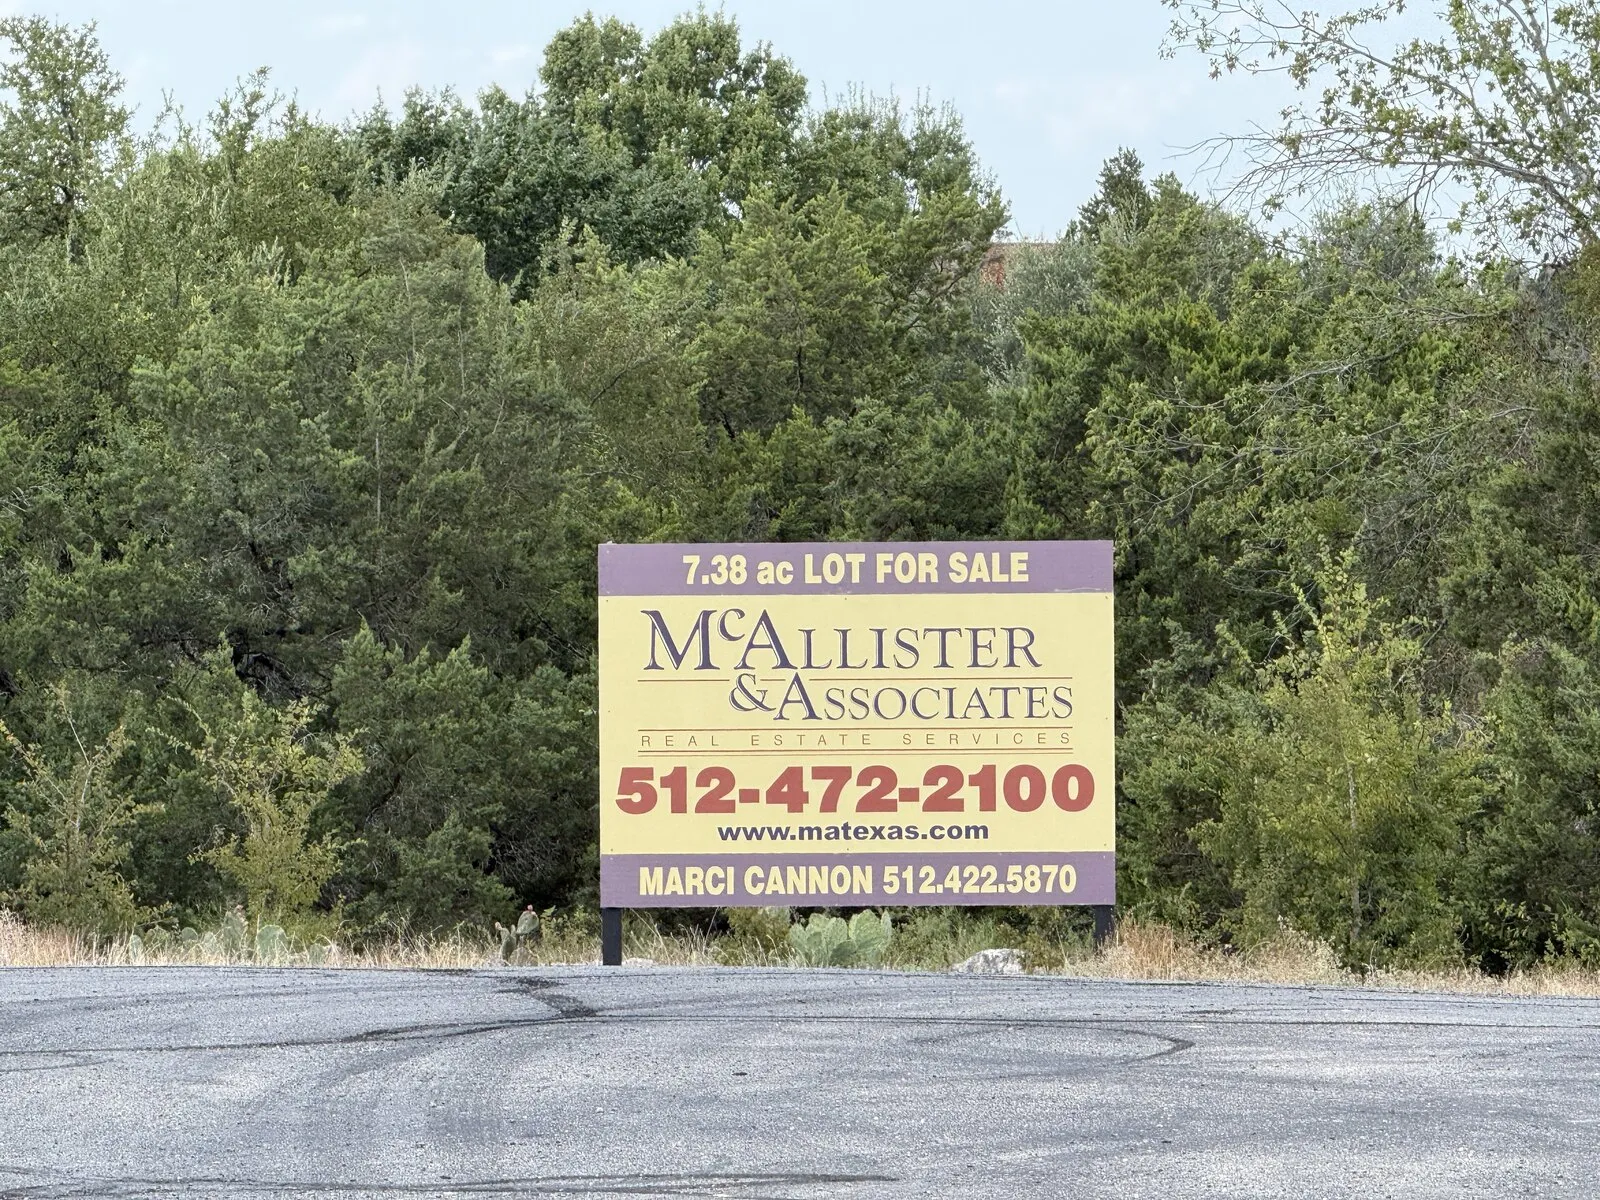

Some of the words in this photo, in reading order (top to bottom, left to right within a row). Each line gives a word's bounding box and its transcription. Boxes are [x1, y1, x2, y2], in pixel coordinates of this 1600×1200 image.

[682, 554, 747, 585] 7.38
[757, 562, 793, 584] ac
[805, 553, 865, 584] LOT
[877, 553, 938, 584] FOR
[949, 552, 1029, 583] SALE
[641, 735, 719, 747] REAL
[752, 734, 871, 746] ESTATE
[902, 732, 1070, 745] SERVICES
[616, 764, 1095, 814] 512-472-2100
[717, 822, 989, 841] www.matexas.com
[639, 866, 734, 896] MARCI
[744, 866, 873, 894] CANNON
[883, 865, 1076, 894] 512.422.5870
